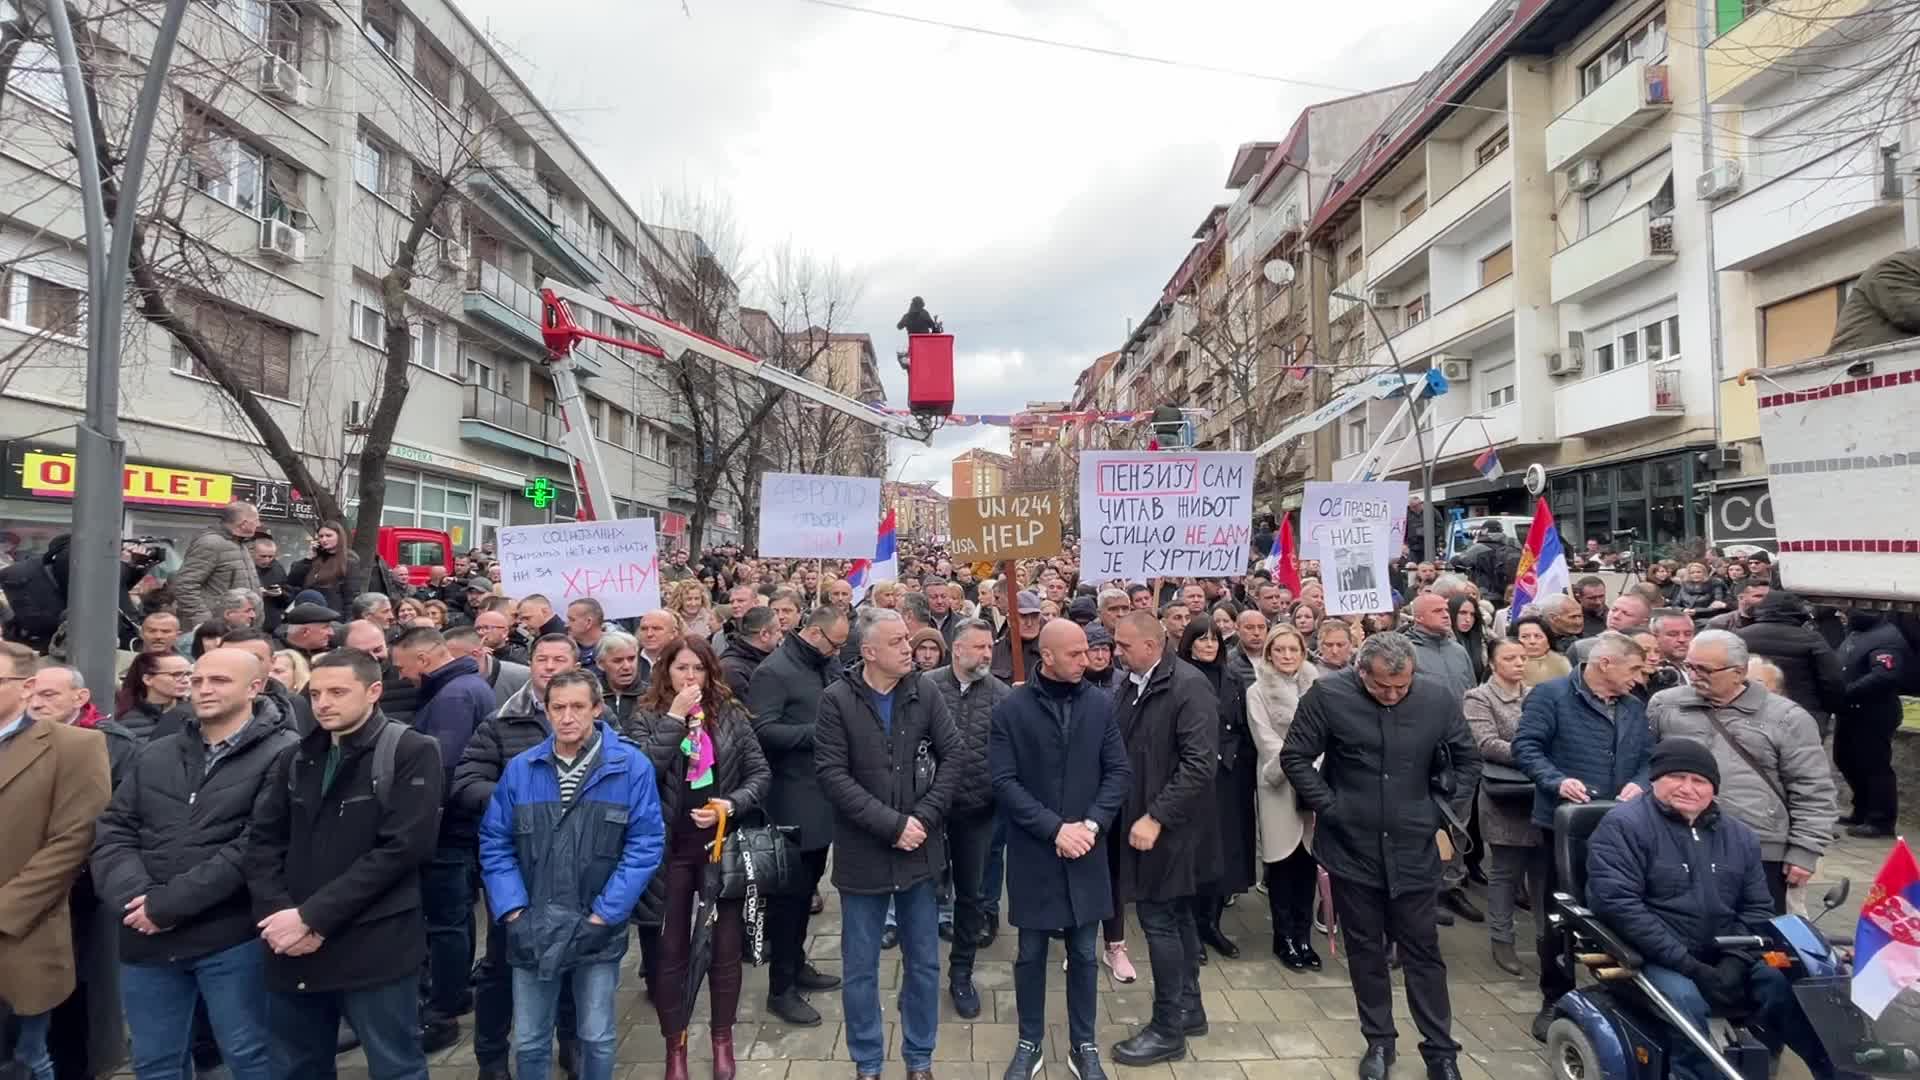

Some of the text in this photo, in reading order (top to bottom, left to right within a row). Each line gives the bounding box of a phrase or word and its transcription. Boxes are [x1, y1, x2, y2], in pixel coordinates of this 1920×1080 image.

[40, 461, 214, 497] OTLET
[1100, 462, 1243, 492] ПЕНЗИЈУ САМ
[978, 495, 1051, 518] UN 1244
[1099, 495, 1240, 523] ЧИТАВ ЖИВОТ
[1344, 499, 1388, 519] ПРАВДА
[952, 520, 1044, 555] USA HELP
[1184, 525, 1207, 544] НЕ
[1209, 525, 1249, 547] ДАМ
[1330, 526, 1373, 545] НИЈЕ
[1101, 546, 1240, 573] ЈЕ КУРТИЈУ!
[536, 567, 552, 579] ЗА
[562, 555, 658, 598] ХРАНУ!
[1339, 592, 1380, 611] КРИВ
